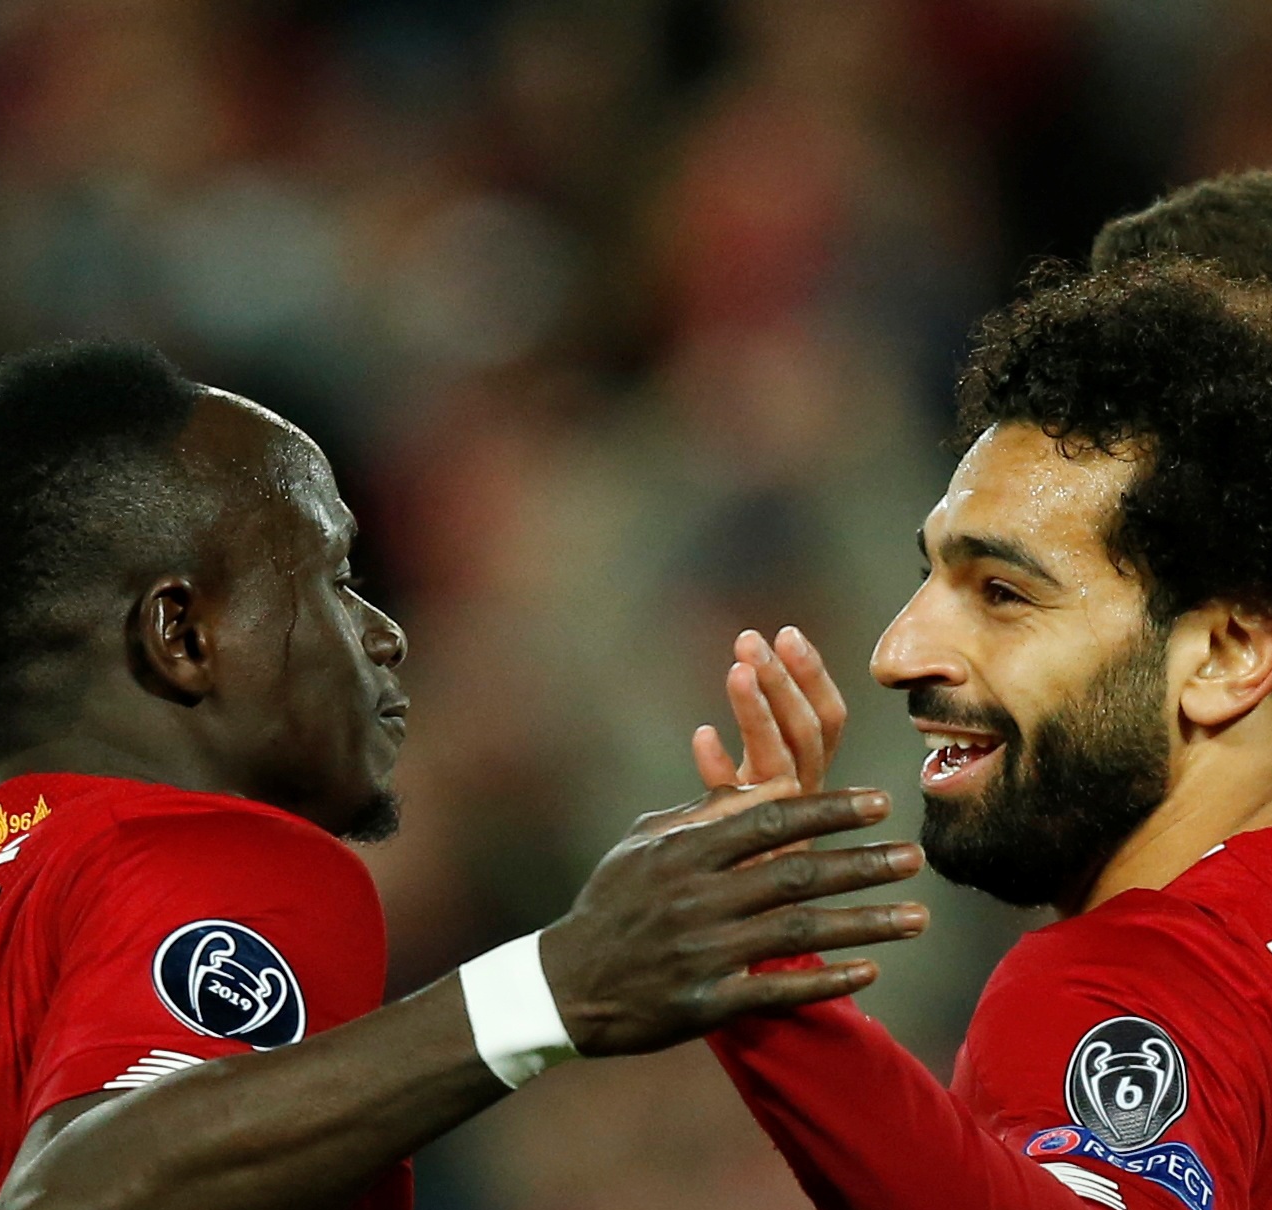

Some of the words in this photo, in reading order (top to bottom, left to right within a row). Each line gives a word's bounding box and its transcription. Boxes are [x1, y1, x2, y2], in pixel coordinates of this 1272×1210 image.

[9, 813, 32, 833] 96
[207, 979, 253, 1011] 2019
[1115, 1075, 1144, 1111] 6
[1083, 1140, 1213, 1206] RESPECT
